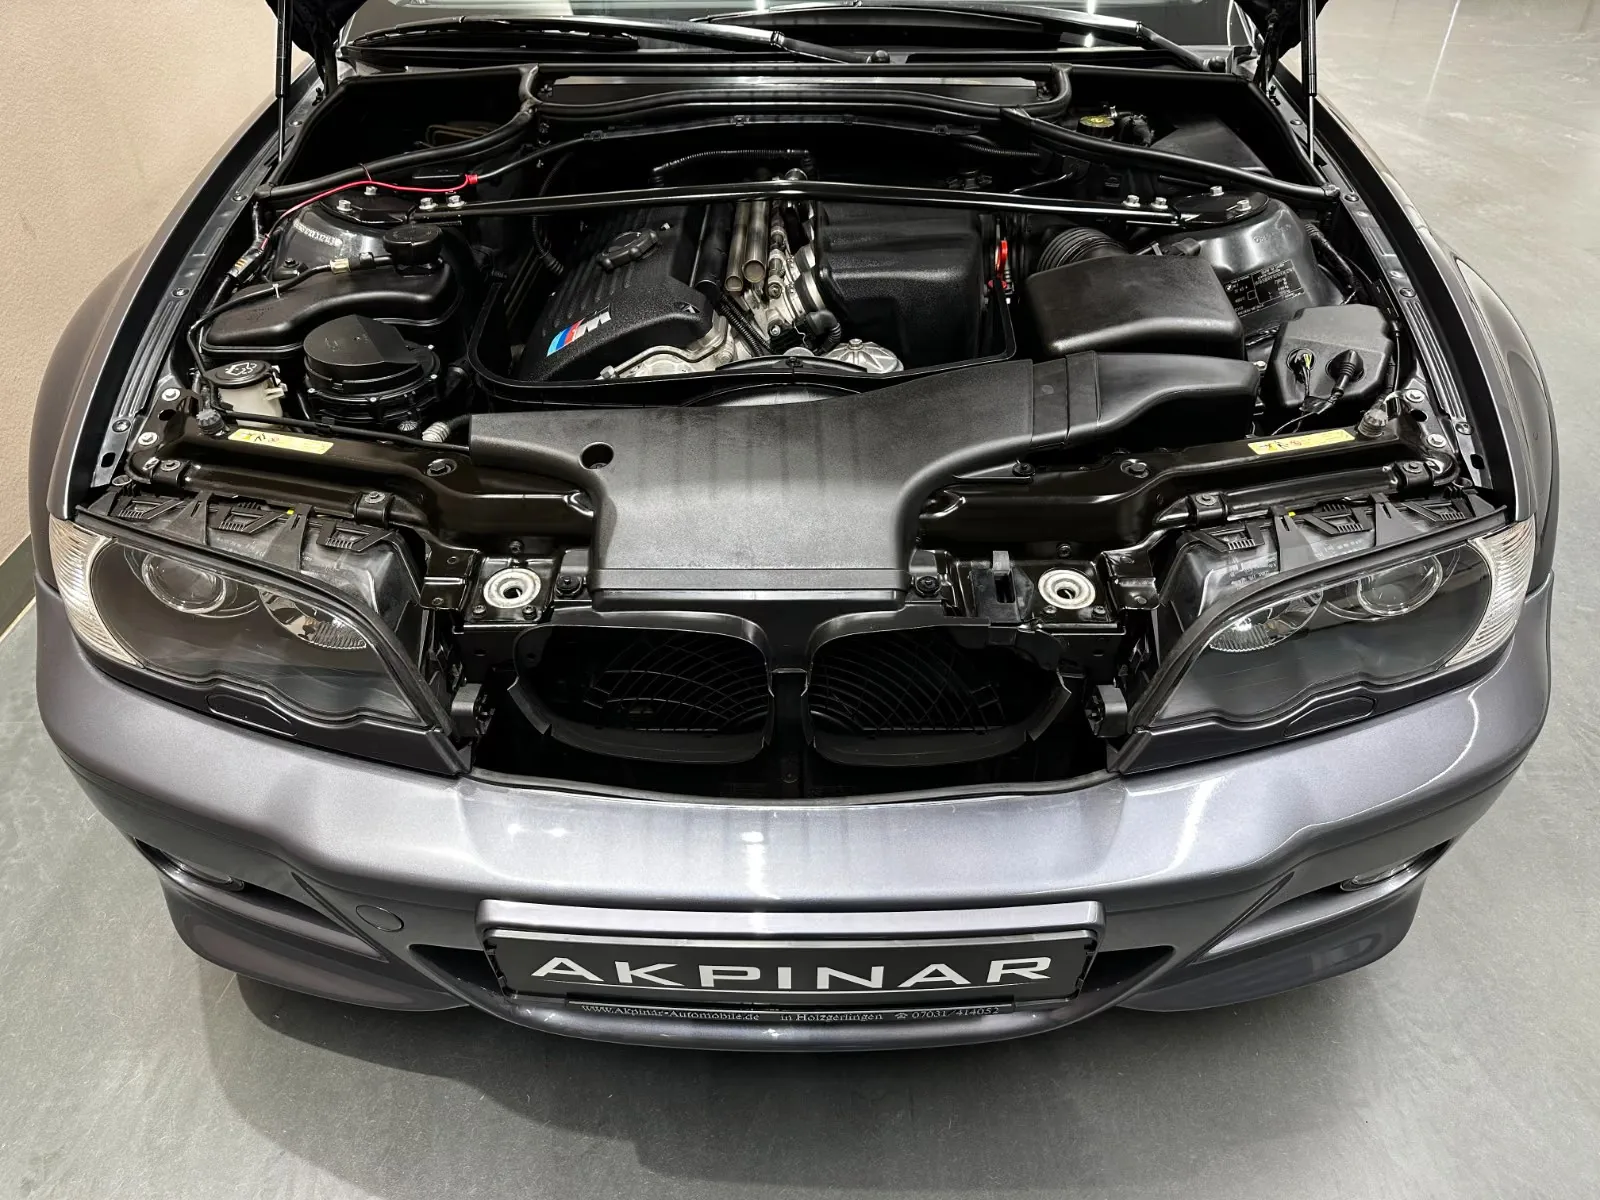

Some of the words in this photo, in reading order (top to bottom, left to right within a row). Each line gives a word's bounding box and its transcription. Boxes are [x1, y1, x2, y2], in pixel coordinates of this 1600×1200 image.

[530, 956, 1052, 989] AKPINAR
[581, 1005, 760, 1021] www.Akpinar-Automobile.de
[780, 1012, 793, 1021] in
[795, 1012, 884, 1023] Holzgerlingen
[911, 1006, 1000, 1019] 07031/414052
